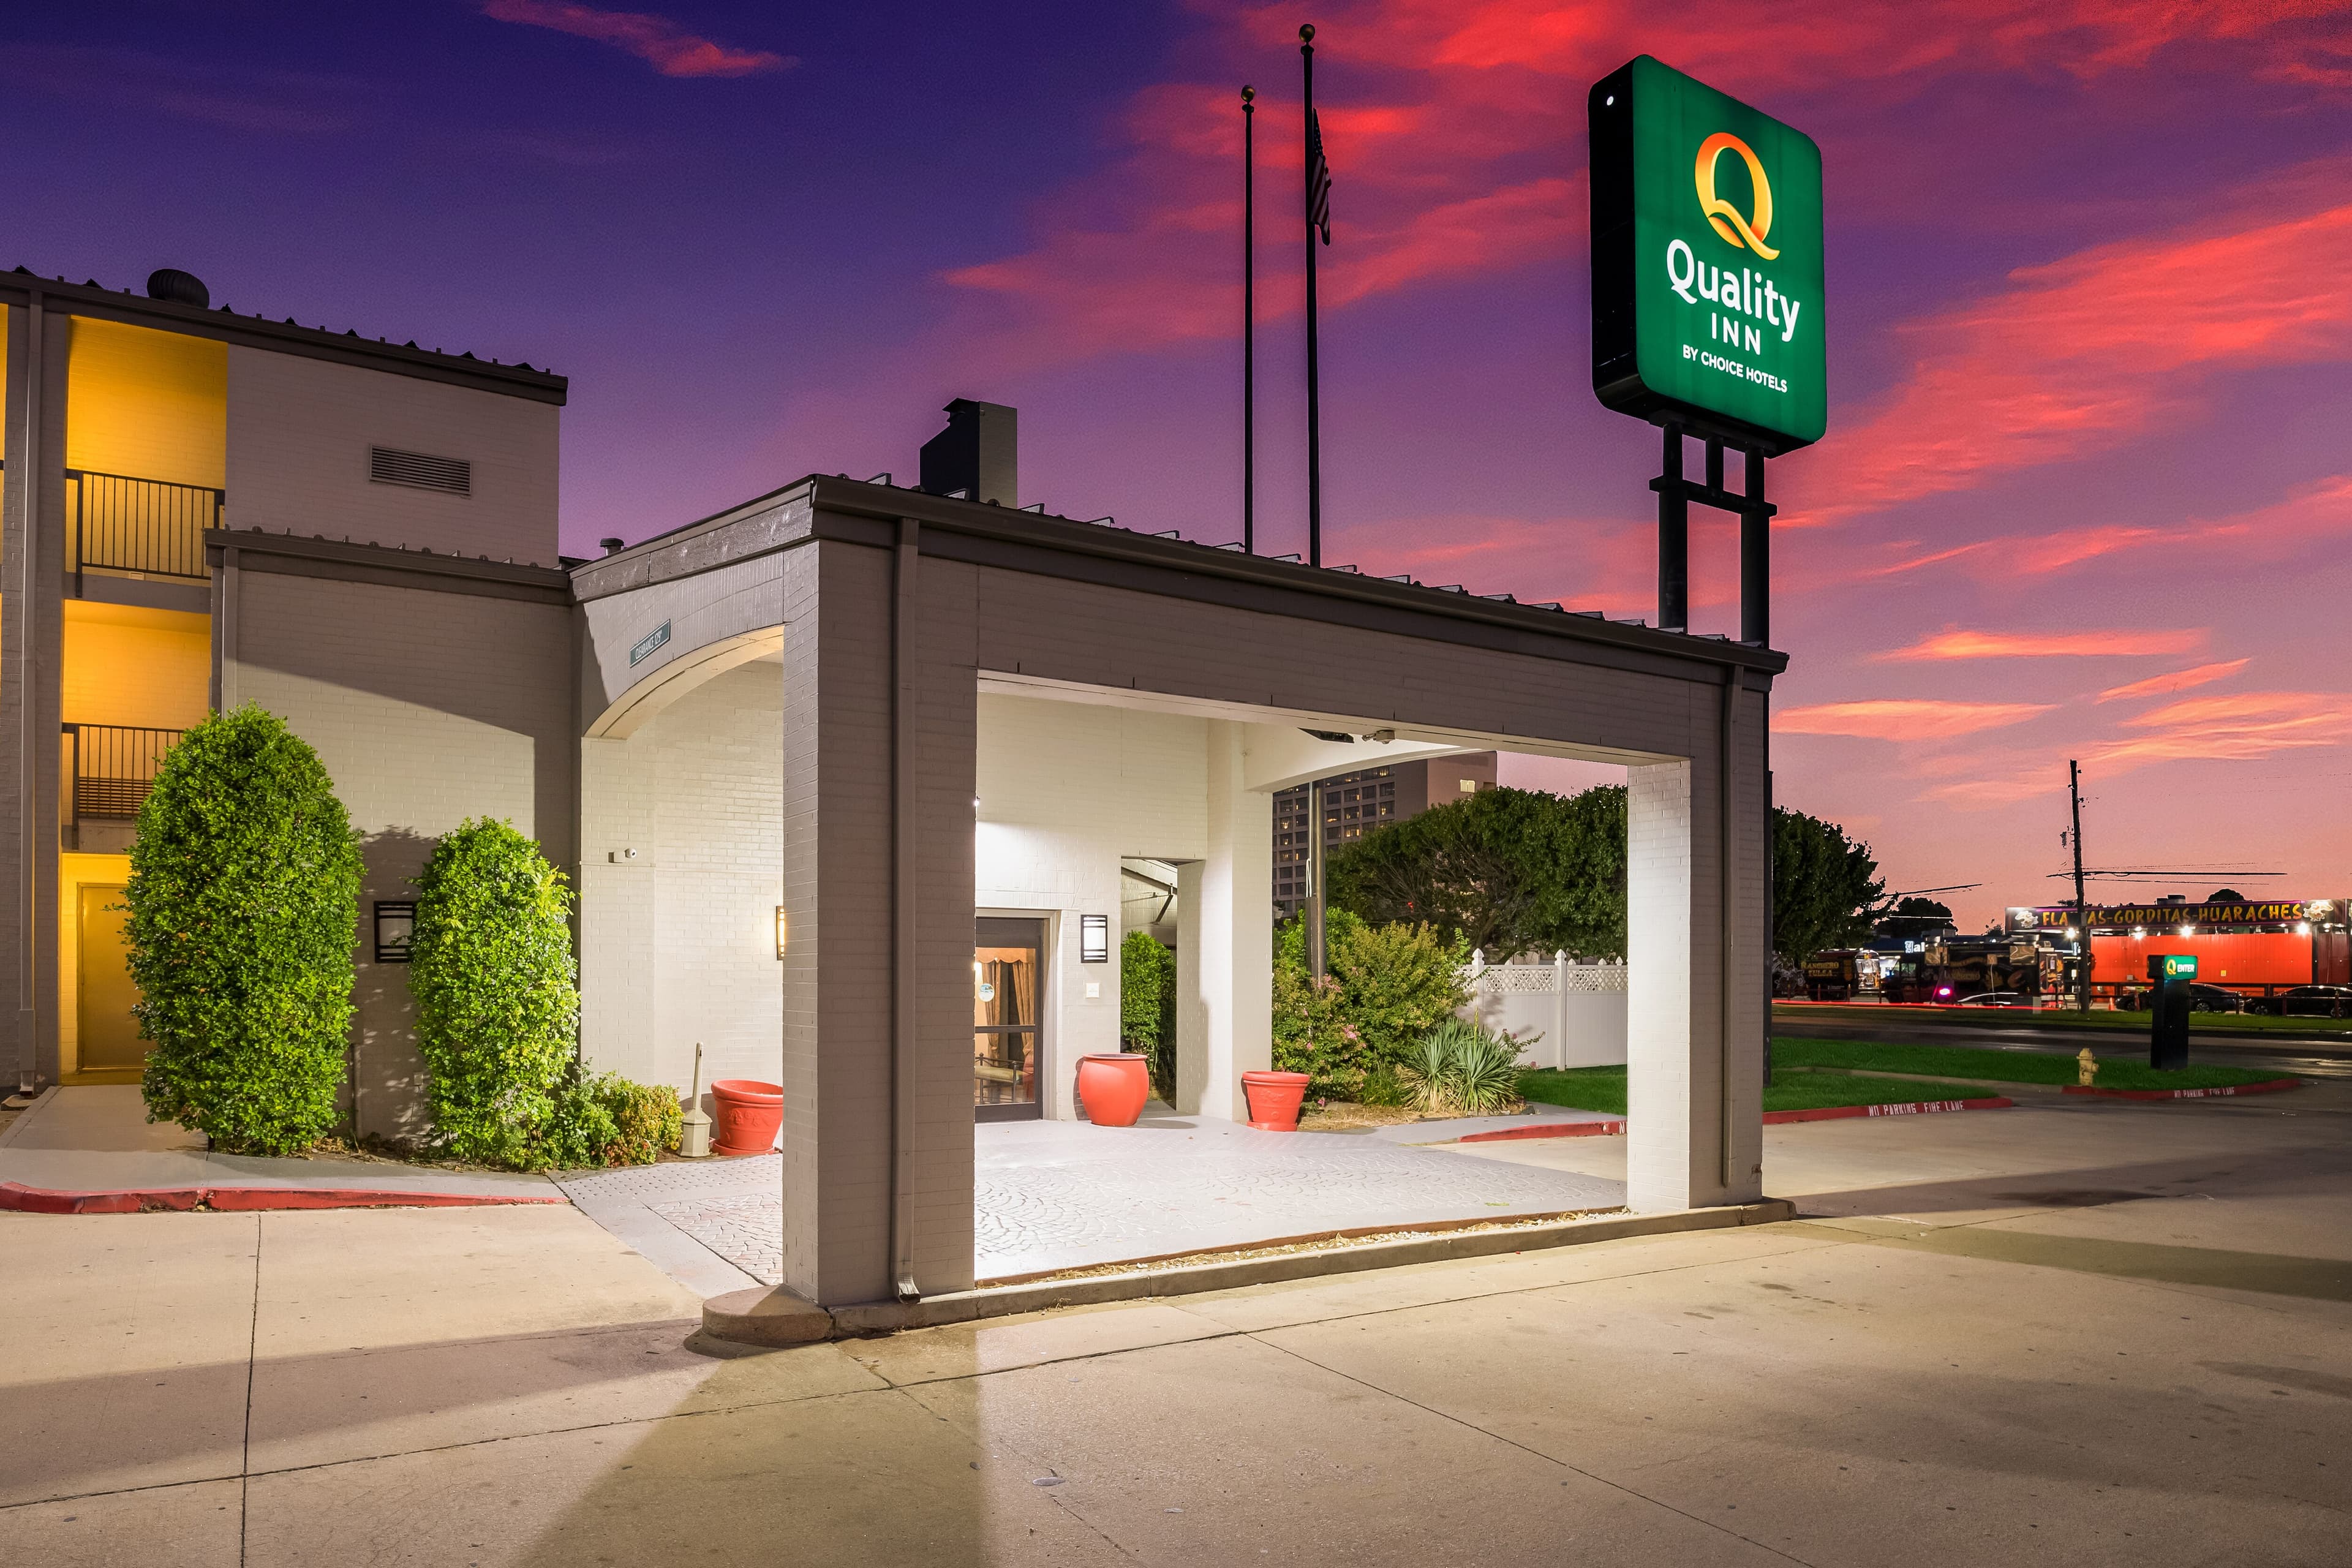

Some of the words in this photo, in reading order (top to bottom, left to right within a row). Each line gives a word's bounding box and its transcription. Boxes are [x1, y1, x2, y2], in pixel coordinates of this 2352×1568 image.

[1695, 132, 1780, 260] Q
[1667, 239, 1800, 342] Quality
[1712, 312, 1760, 355] INN
[1683, 344, 1698, 361] BY
[1701, 352, 1744, 377] CHOICE
[1746, 367, 1787, 393] HOTELS
[635, 636, 654, 660] CLEARANCE
[2177, 964, 2195, 973] ENTER
[1869, 1106, 1880, 1117] NO
[1883, 1103, 1917, 1115] PARKING
[1923, 1101, 1940, 1113] FIRE
[1945, 1101, 1965, 1111] LANE
